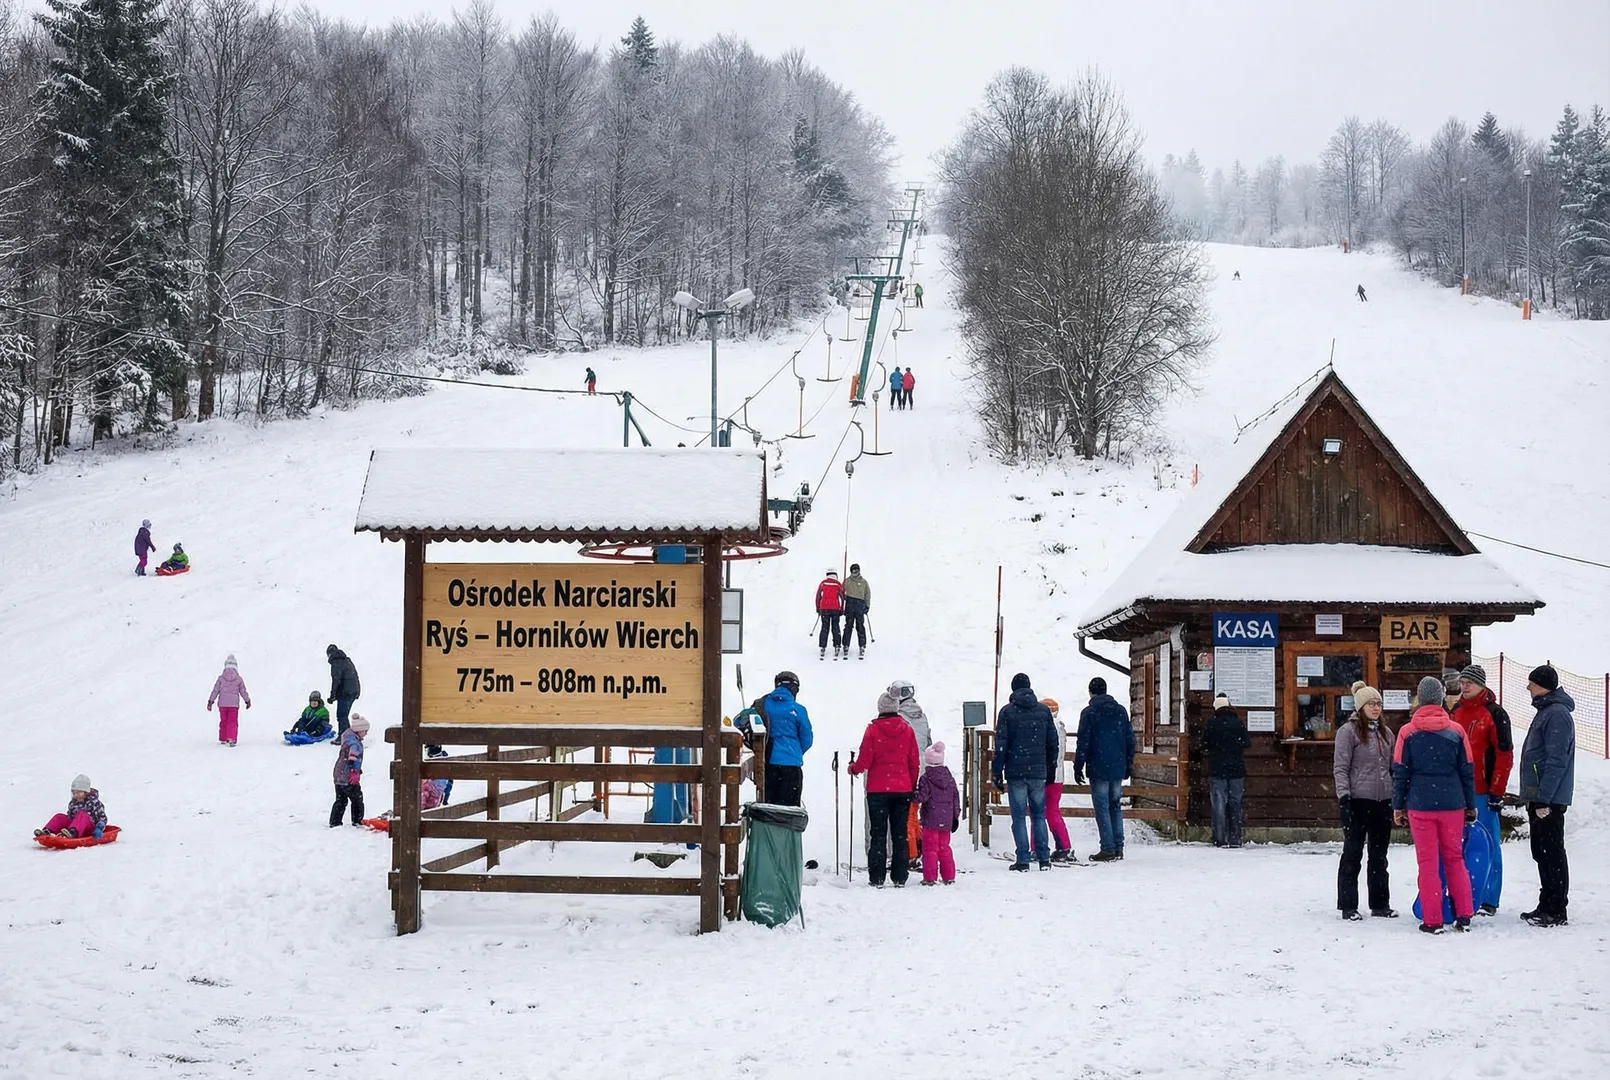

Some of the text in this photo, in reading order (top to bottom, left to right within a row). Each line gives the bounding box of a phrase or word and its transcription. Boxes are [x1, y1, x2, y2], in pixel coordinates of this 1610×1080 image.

[448, 579, 676, 608] Ośrodek Narciarski
[426, 620, 469, 654] Ryś
[496, 620, 609, 649] Horników
[616, 620, 699, 649] Wierch
[1217, 620, 1275, 639] KASA
[1390, 621, 1440, 640] BAR
[456, 668, 514, 693] 775m
[537, 668, 596, 693] 808m
[603, 675, 667, 699] n.p.m.
